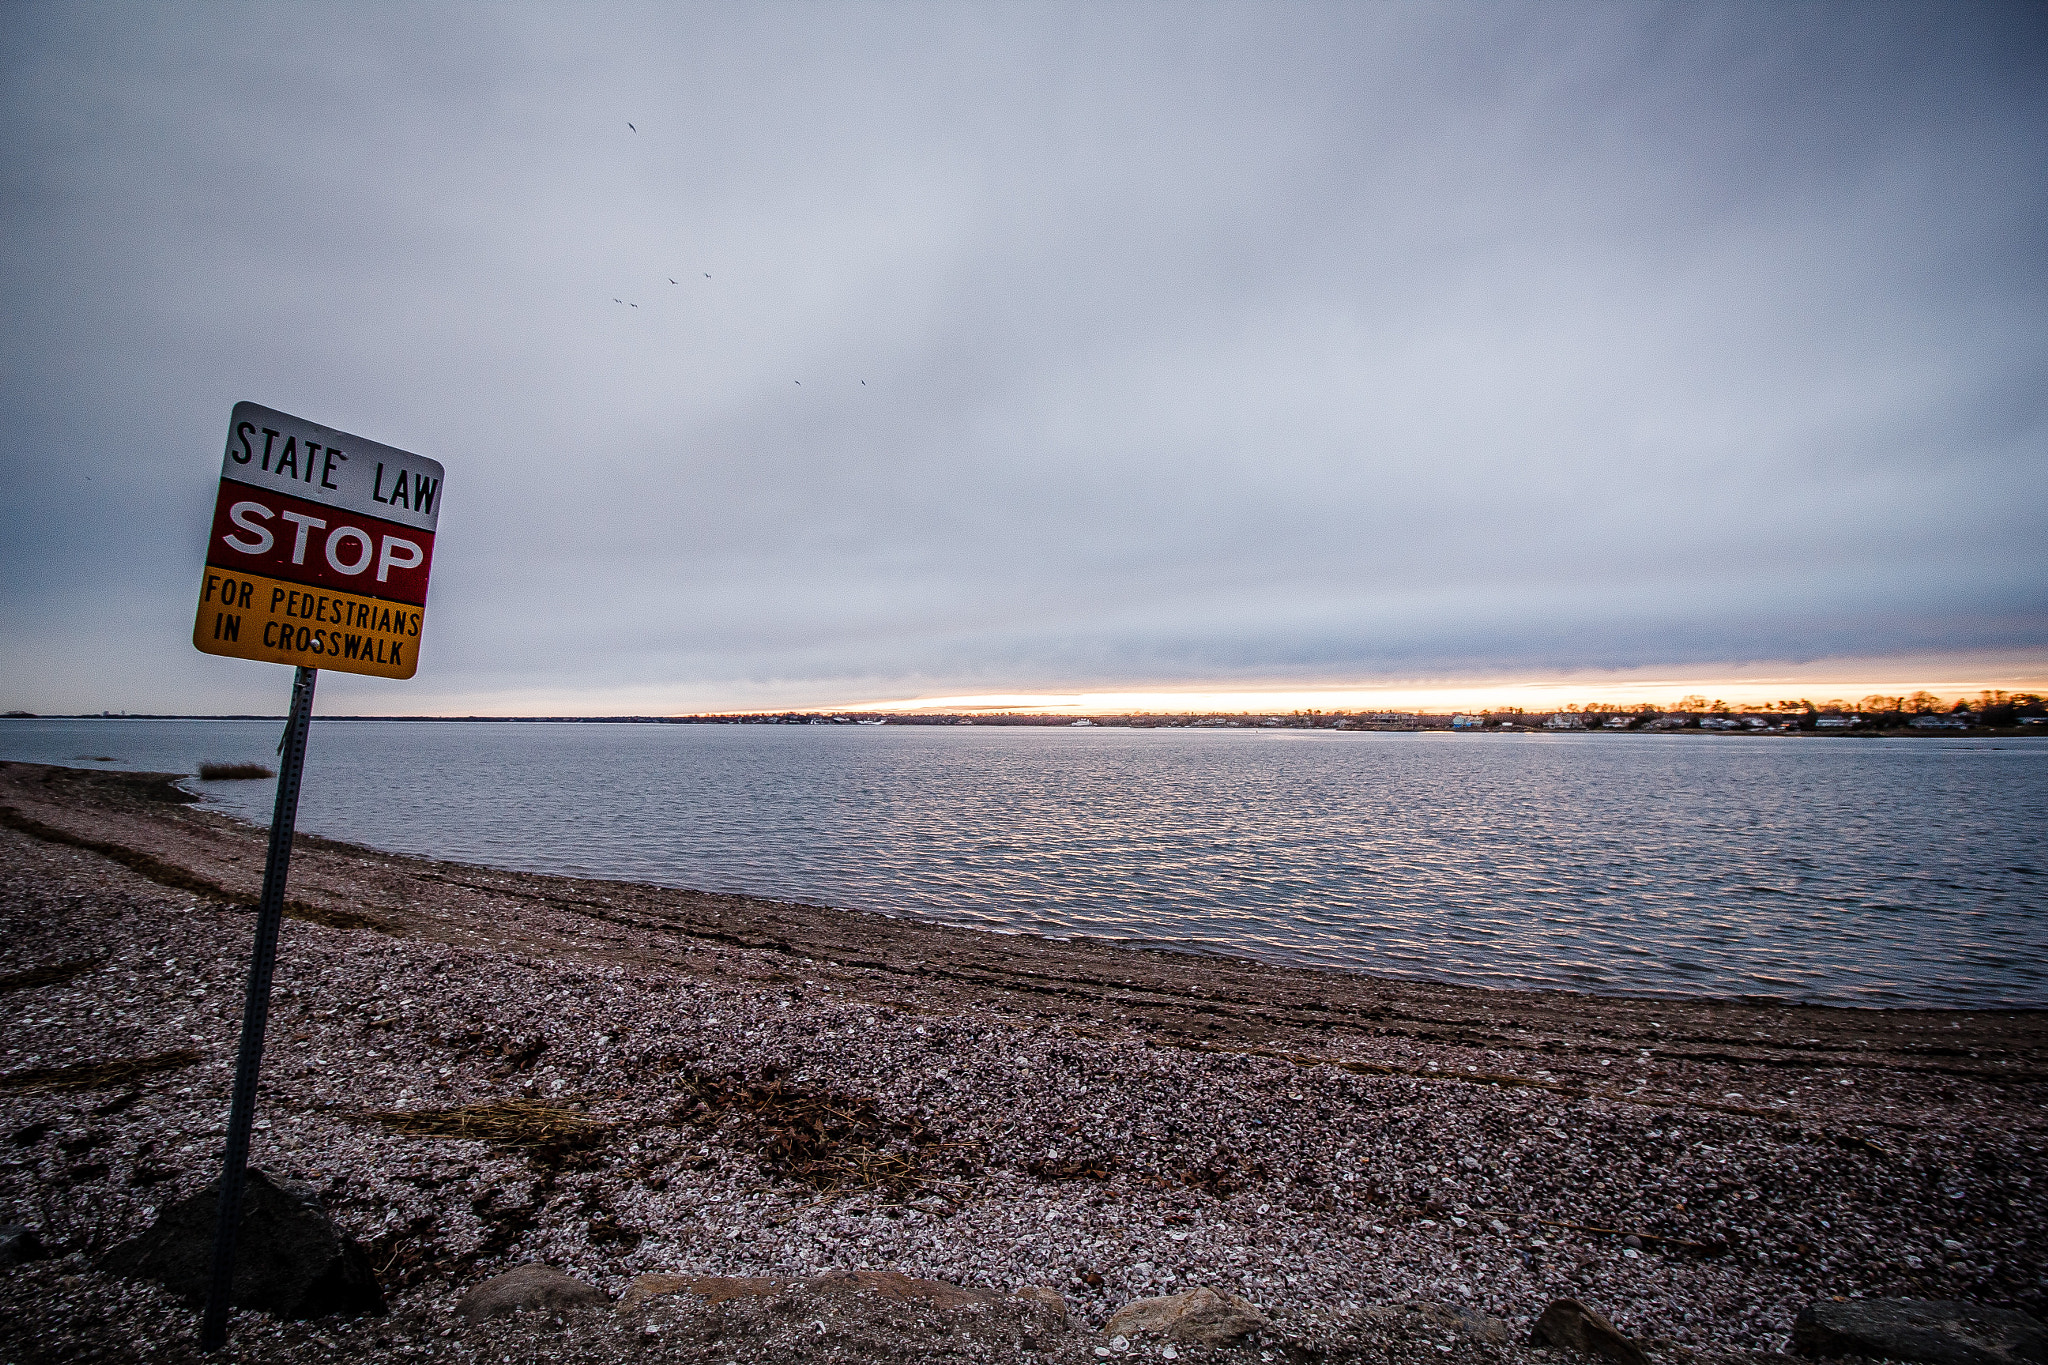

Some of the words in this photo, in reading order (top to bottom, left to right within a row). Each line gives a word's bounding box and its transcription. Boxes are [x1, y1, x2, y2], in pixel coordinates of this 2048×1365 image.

[231, 421, 344, 490] STATE
[372, 462, 439, 515] LAW
[222, 501, 424, 582] STOP
[204, 574, 254, 610] FOR
[269, 587, 420, 637] PEDESTRIANS
[213, 612, 241, 643] IN
[263, 621, 404, 666] CROSSWALK
